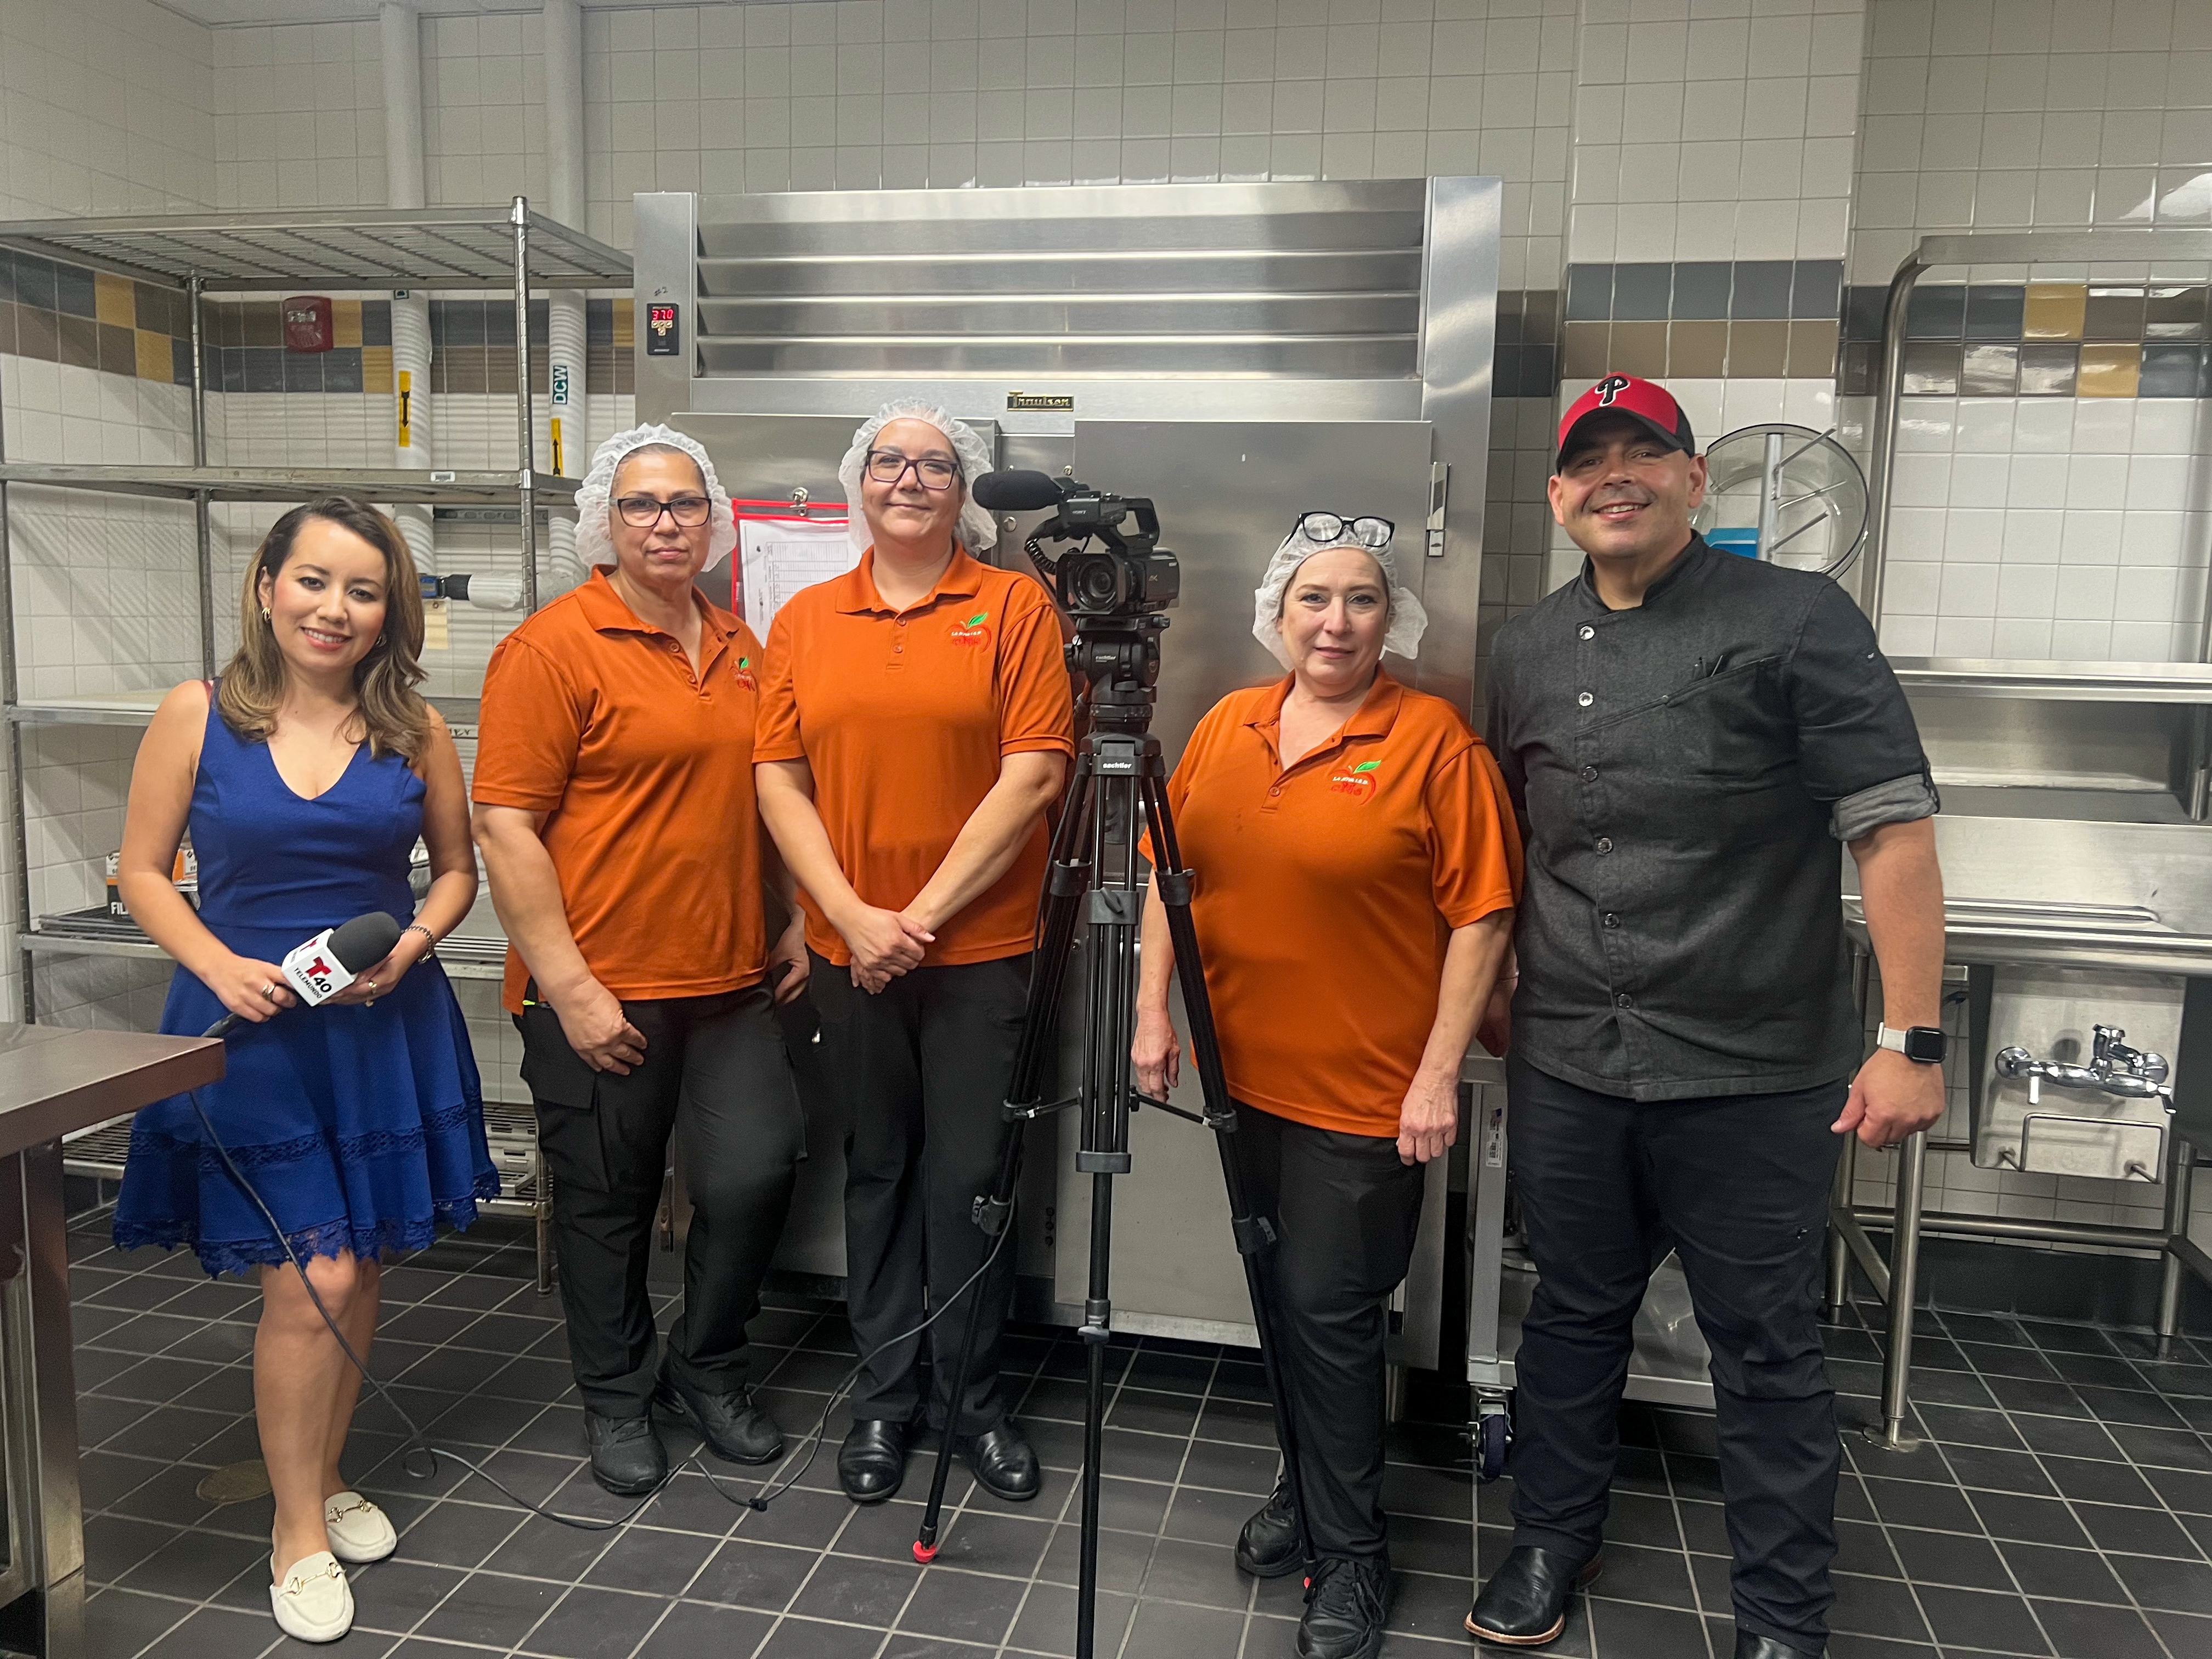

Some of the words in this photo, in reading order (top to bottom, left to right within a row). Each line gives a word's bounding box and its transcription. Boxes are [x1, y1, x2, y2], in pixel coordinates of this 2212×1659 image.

[554, 366, 567, 403] DCW
[1594, 376, 1630, 407] P
[111, 901, 129, 915] FIL
[294, 967, 323, 998] TELEMUNDO
[313, 977, 332, 992] 40
